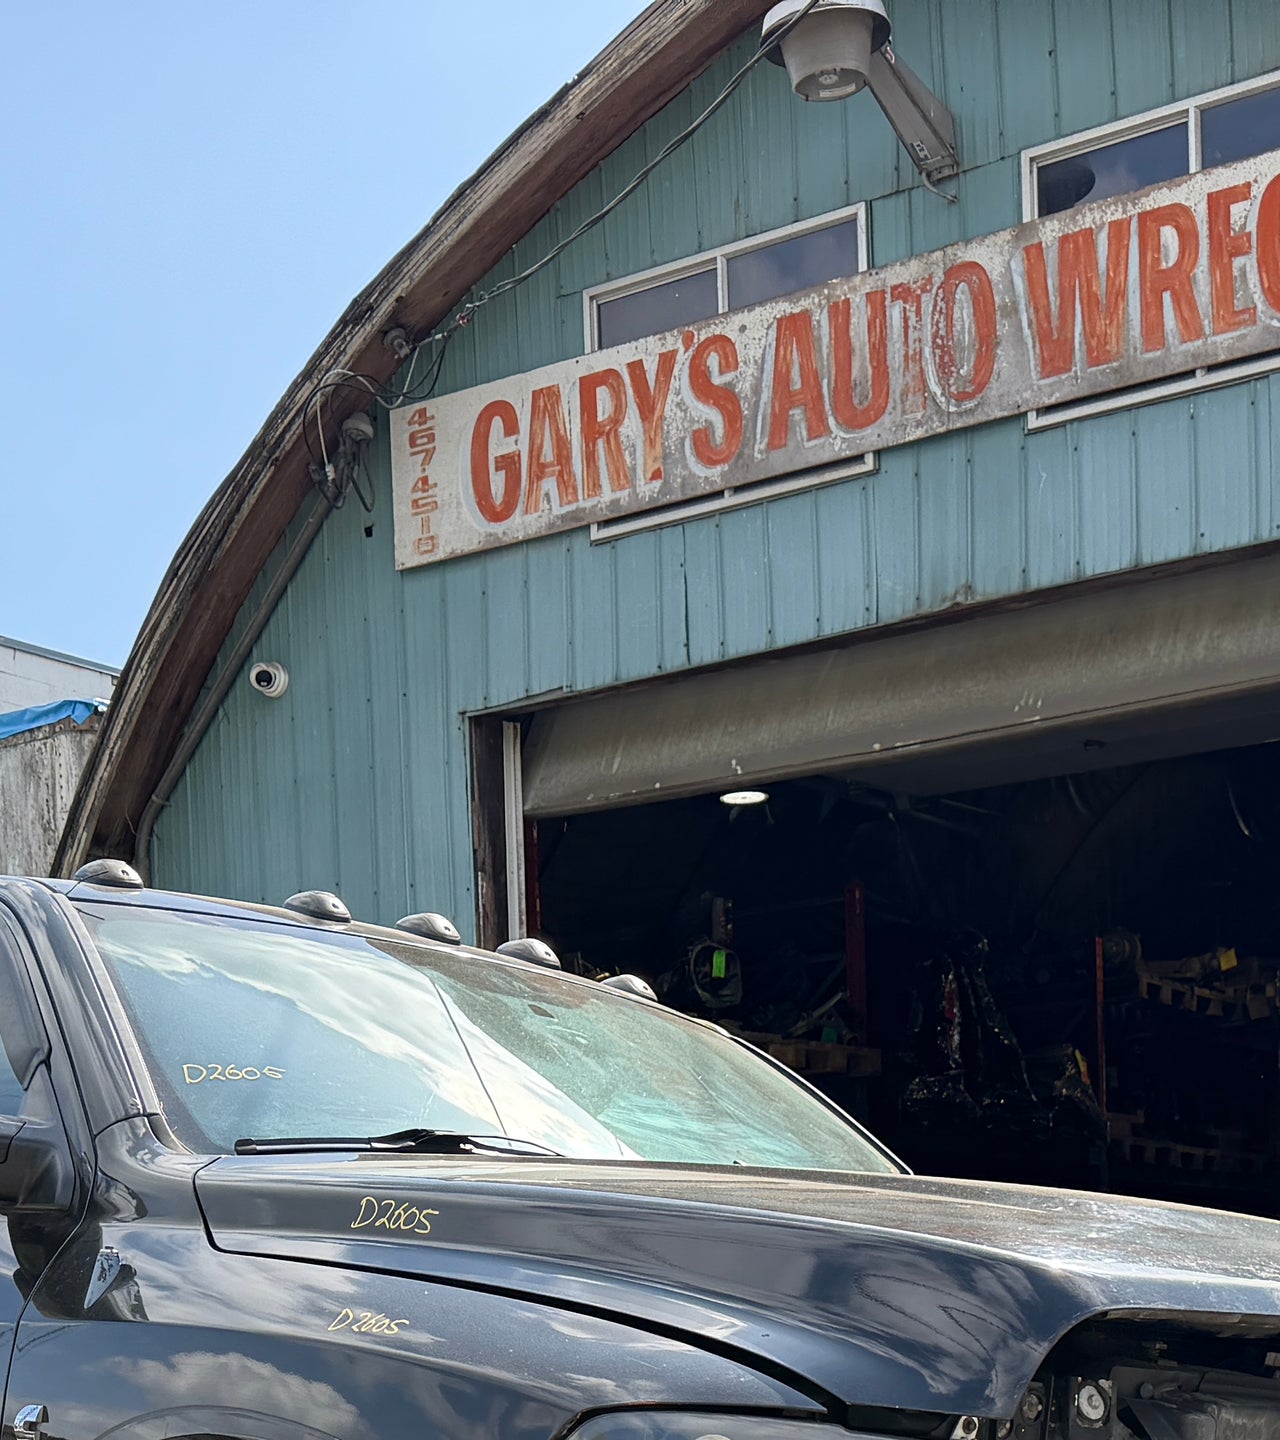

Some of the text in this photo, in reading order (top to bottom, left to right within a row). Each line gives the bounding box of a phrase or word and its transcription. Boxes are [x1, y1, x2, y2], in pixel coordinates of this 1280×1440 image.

[468, 330, 742, 525] GARY'S
[764, 261, 997, 451] AUTO
[351, 1196, 440, 1234] D2605
[327, 1308, 410, 1334] D2605
